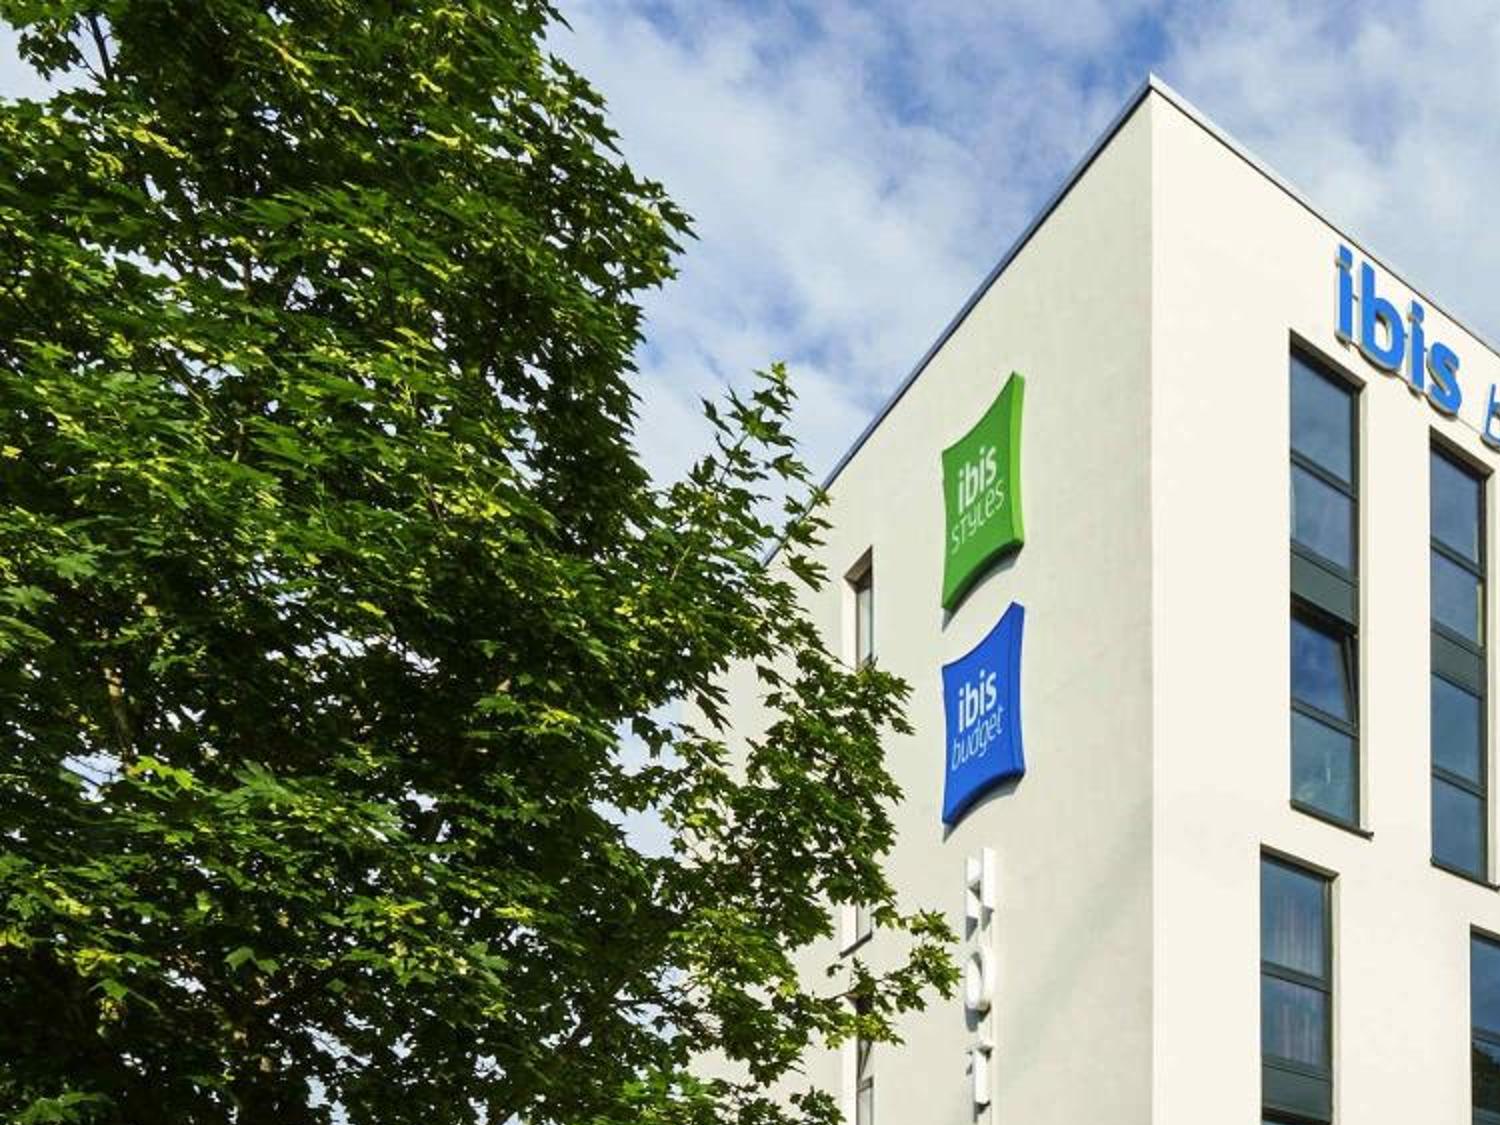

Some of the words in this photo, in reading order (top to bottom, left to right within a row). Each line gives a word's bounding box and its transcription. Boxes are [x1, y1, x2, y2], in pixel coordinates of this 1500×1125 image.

[1336, 244, 1462, 416] ibis
[959, 447, 997, 514] ibis
[959, 669, 997, 732] ibis
[951, 705, 1003, 771] budget
